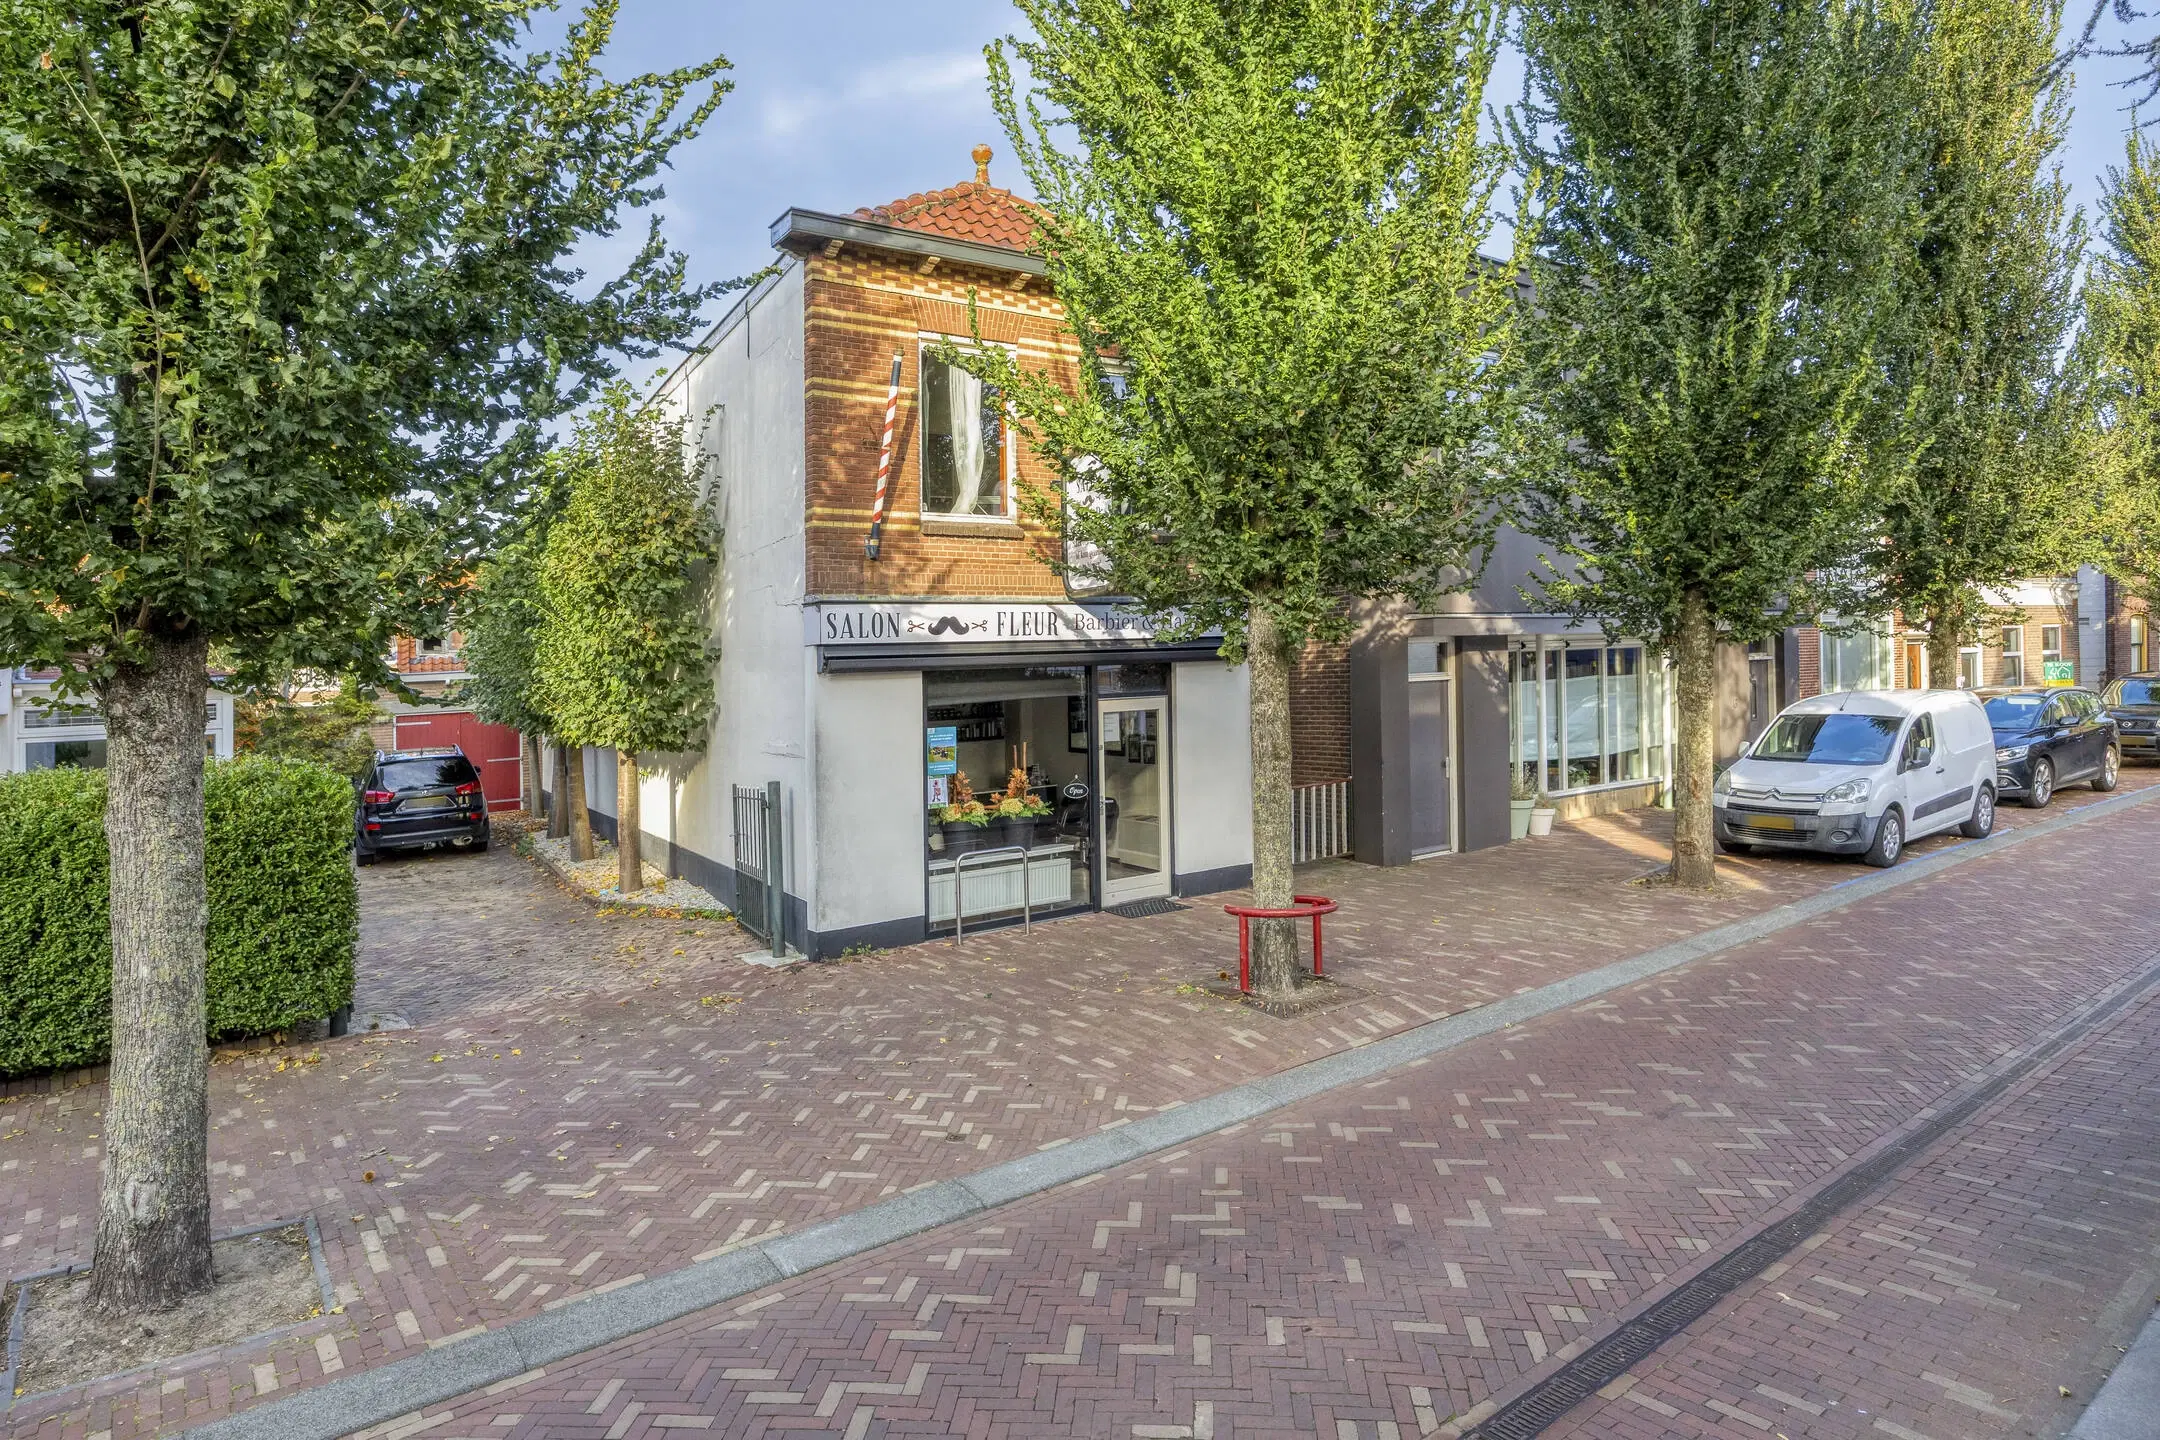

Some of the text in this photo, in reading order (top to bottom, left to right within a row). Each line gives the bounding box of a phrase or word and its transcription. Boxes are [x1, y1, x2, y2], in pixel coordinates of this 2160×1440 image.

[826, 611, 901, 639] SALON
[996, 610, 1059, 637] FLEUR
[1074, 612, 1139, 631] Barbier
[1142, 614, 1155, 631] &
